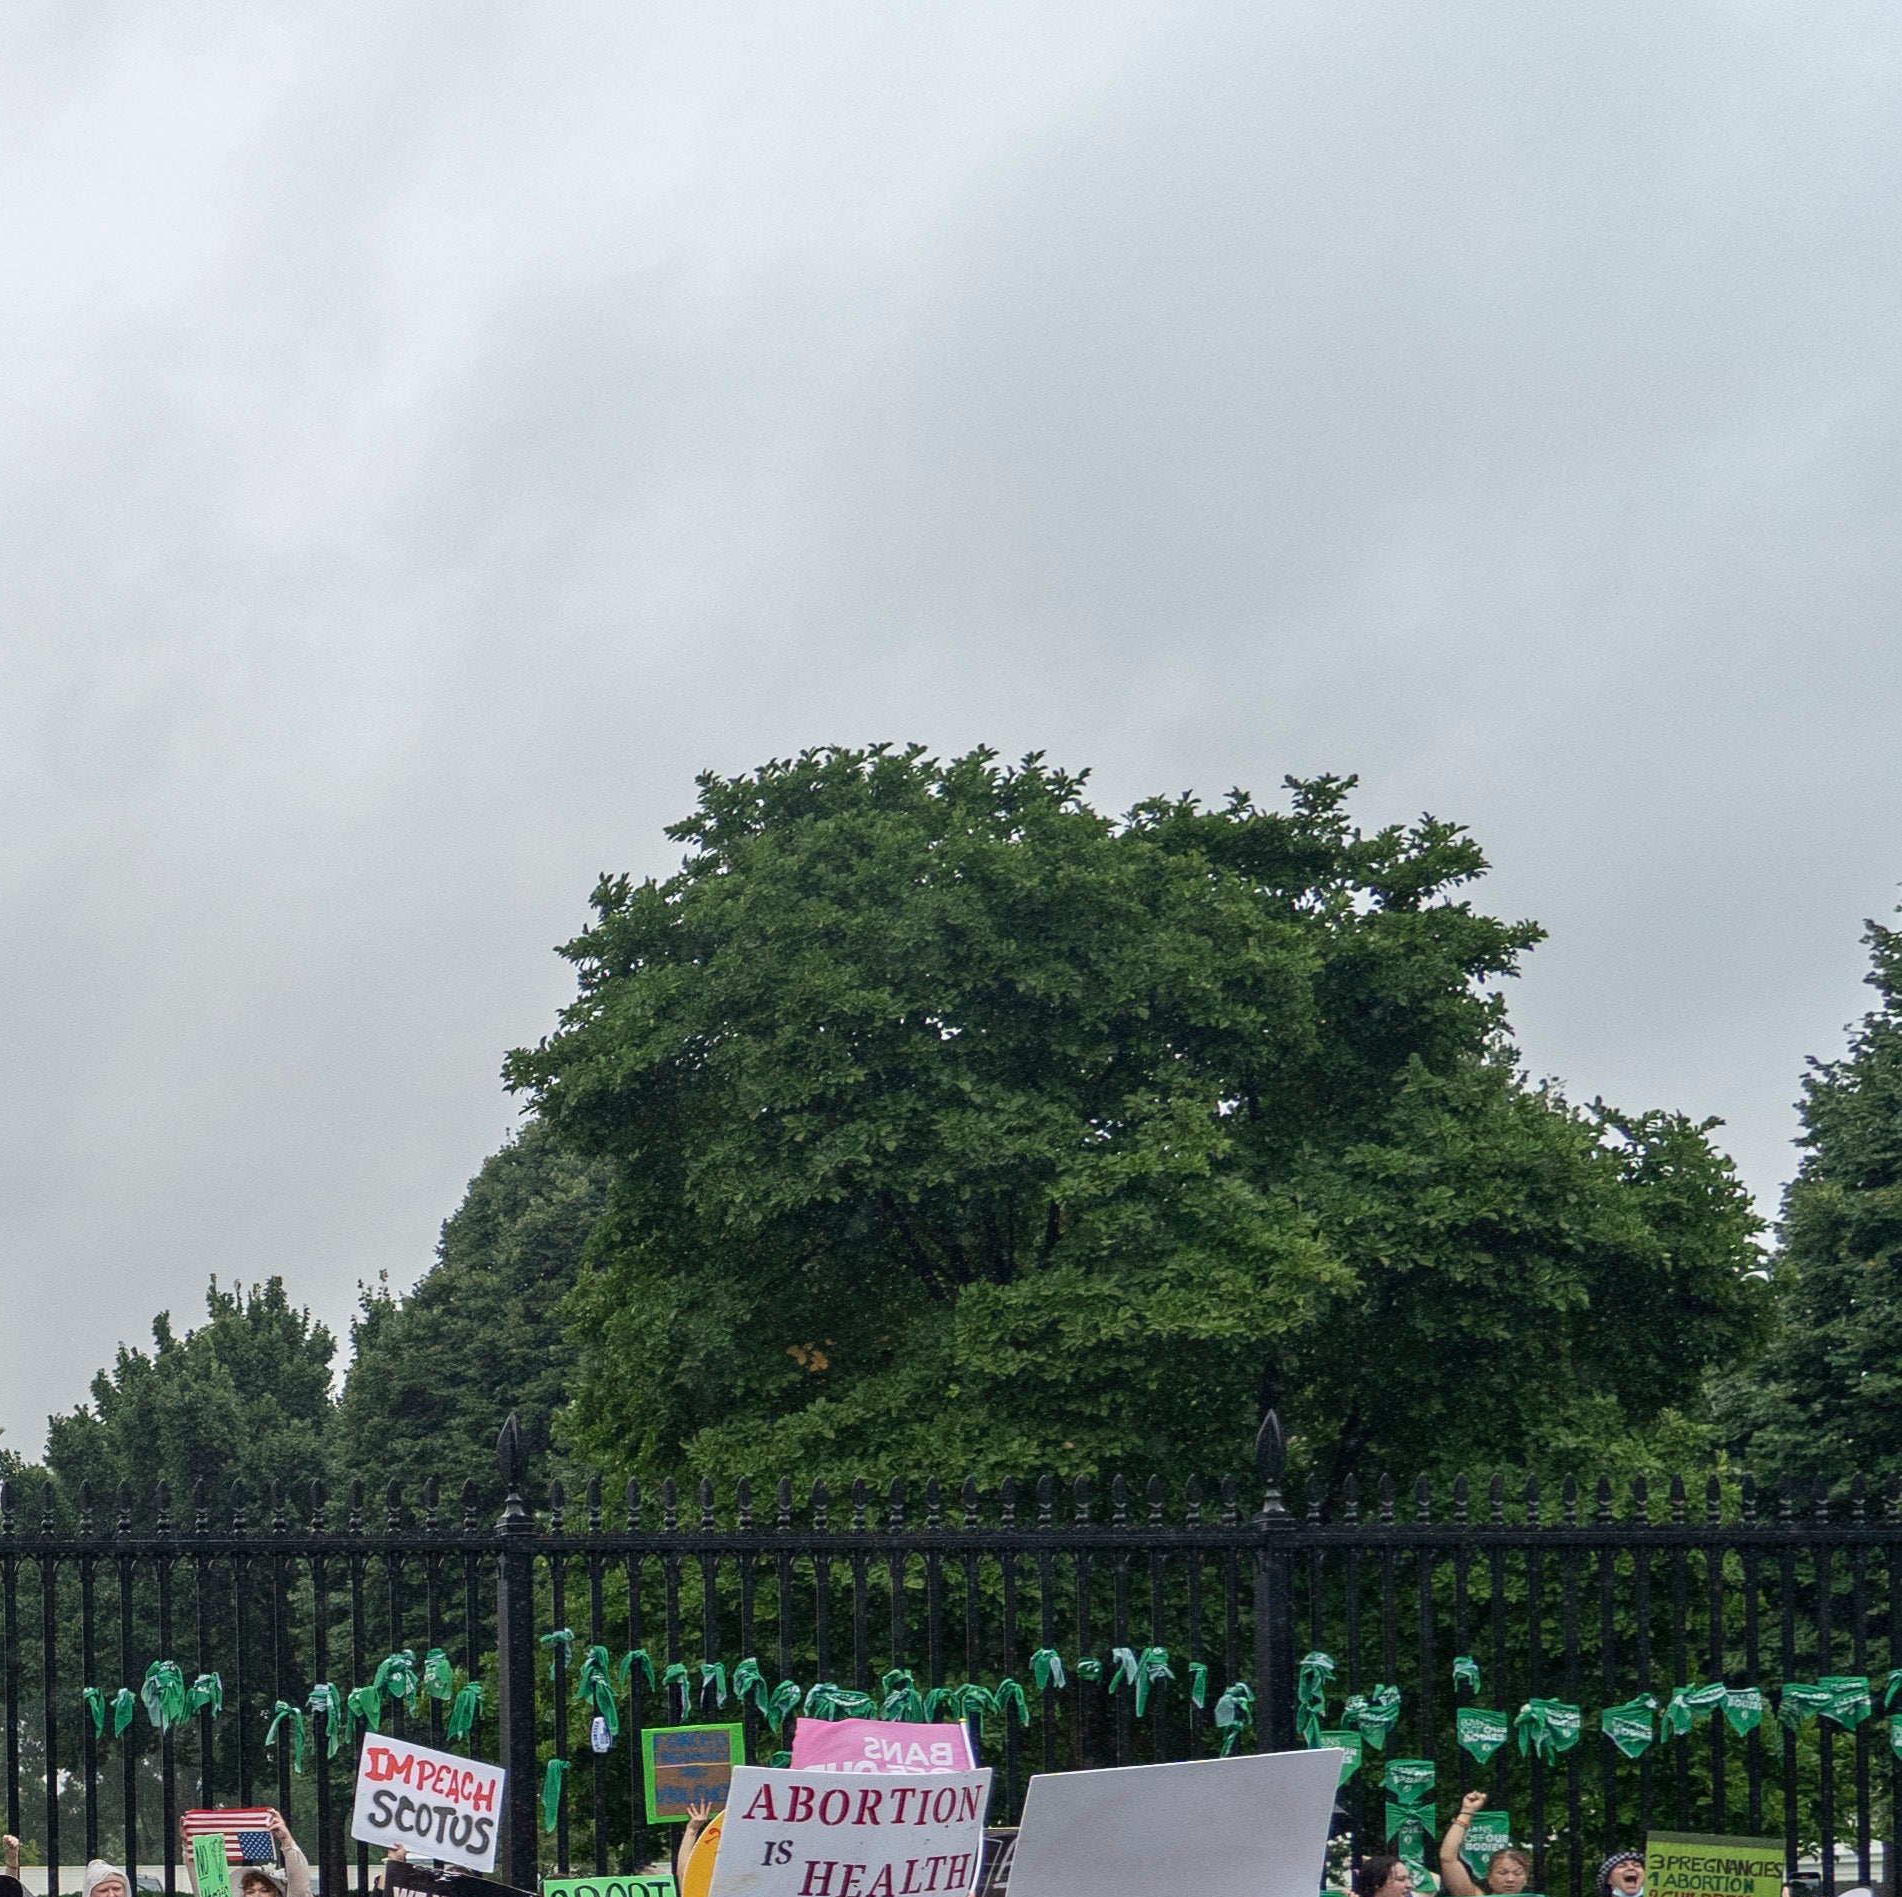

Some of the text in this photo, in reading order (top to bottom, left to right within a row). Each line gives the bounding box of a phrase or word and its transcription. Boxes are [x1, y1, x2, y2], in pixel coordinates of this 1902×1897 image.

[365, 1747, 497, 1813] IMPEACH
[742, 1783, 982, 1826] ABORTION
[368, 1789, 494, 1855] SCOTUS
[761, 1840, 794, 1866] IS
[1649, 1853, 1785, 1879] 3 PREGNANCIES
[1648, 1872, 1755, 1894] 1 ABORTION
